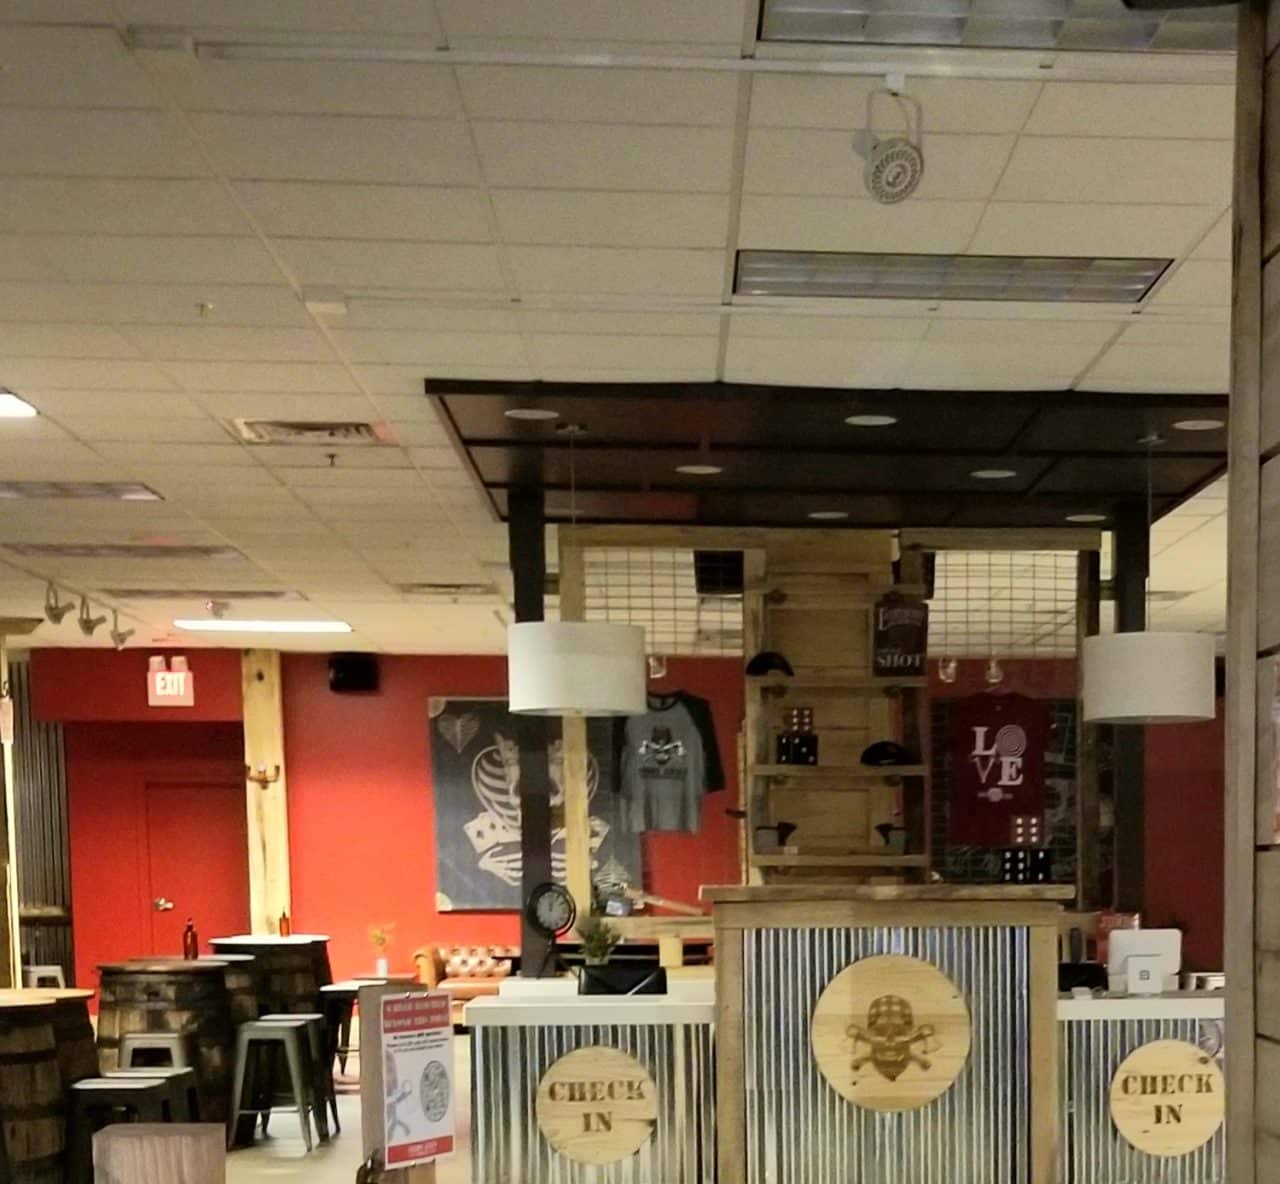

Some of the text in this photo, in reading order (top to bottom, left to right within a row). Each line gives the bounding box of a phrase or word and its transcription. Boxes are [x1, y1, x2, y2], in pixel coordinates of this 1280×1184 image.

[156, 671, 185, 696] EXIT
[548, 1080, 646, 1102] CHECK
[1121, 1073, 1214, 1095] CHECK
[582, 1111, 613, 1132] IN
[1153, 1103, 1183, 1124] IN
